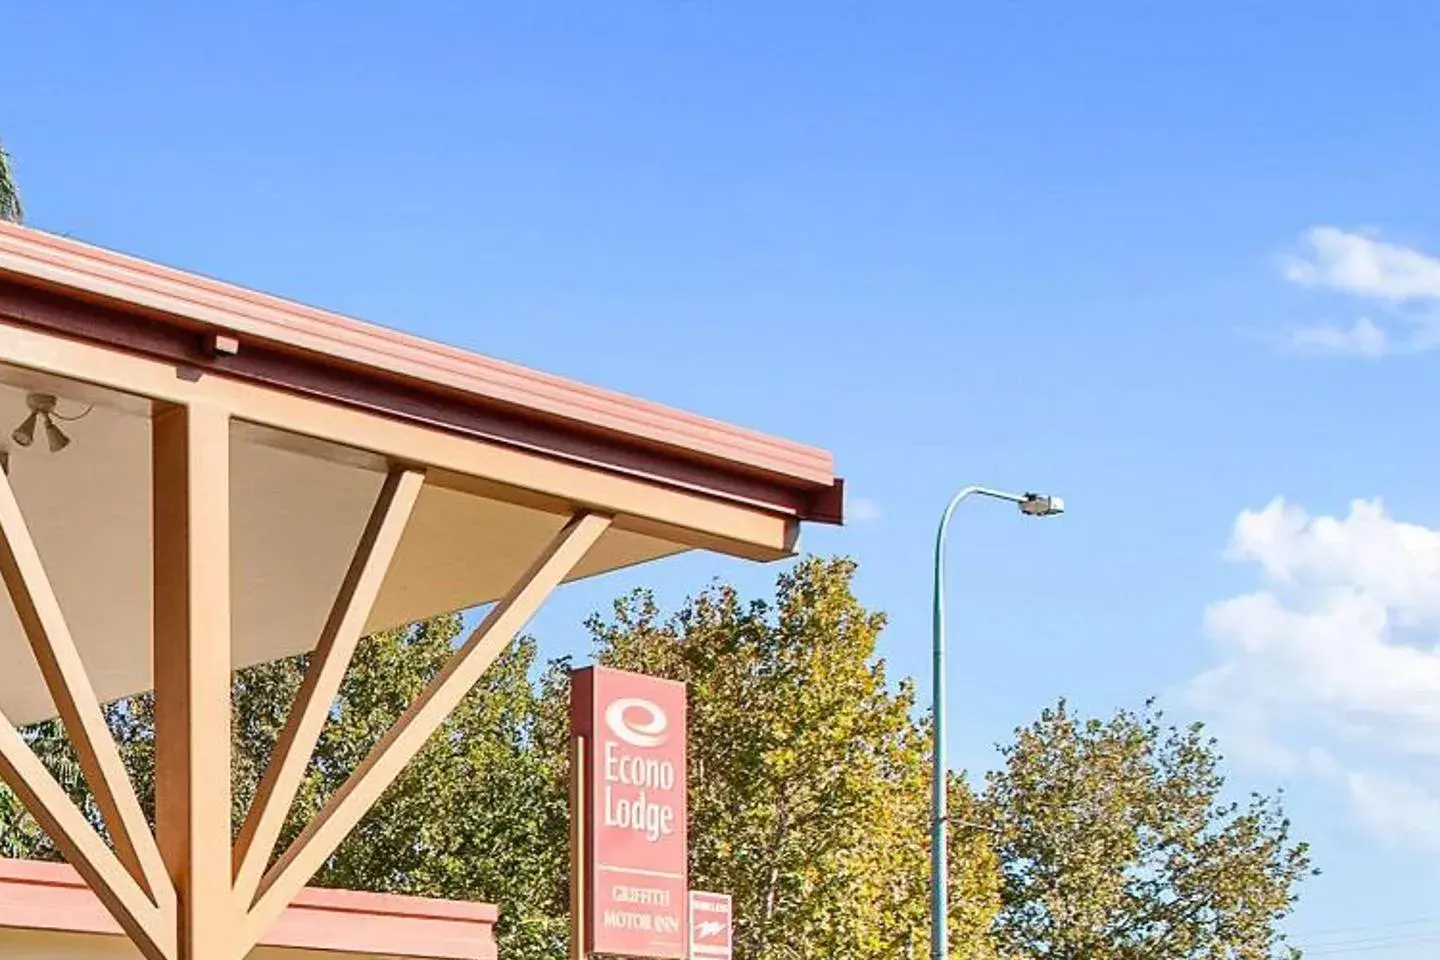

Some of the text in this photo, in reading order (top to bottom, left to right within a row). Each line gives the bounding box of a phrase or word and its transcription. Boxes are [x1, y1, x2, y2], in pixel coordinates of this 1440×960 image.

[604, 741, 674, 790] Econo
[604, 785, 674, 842] Lodge
[603, 908, 679, 934] MOTOR INN
